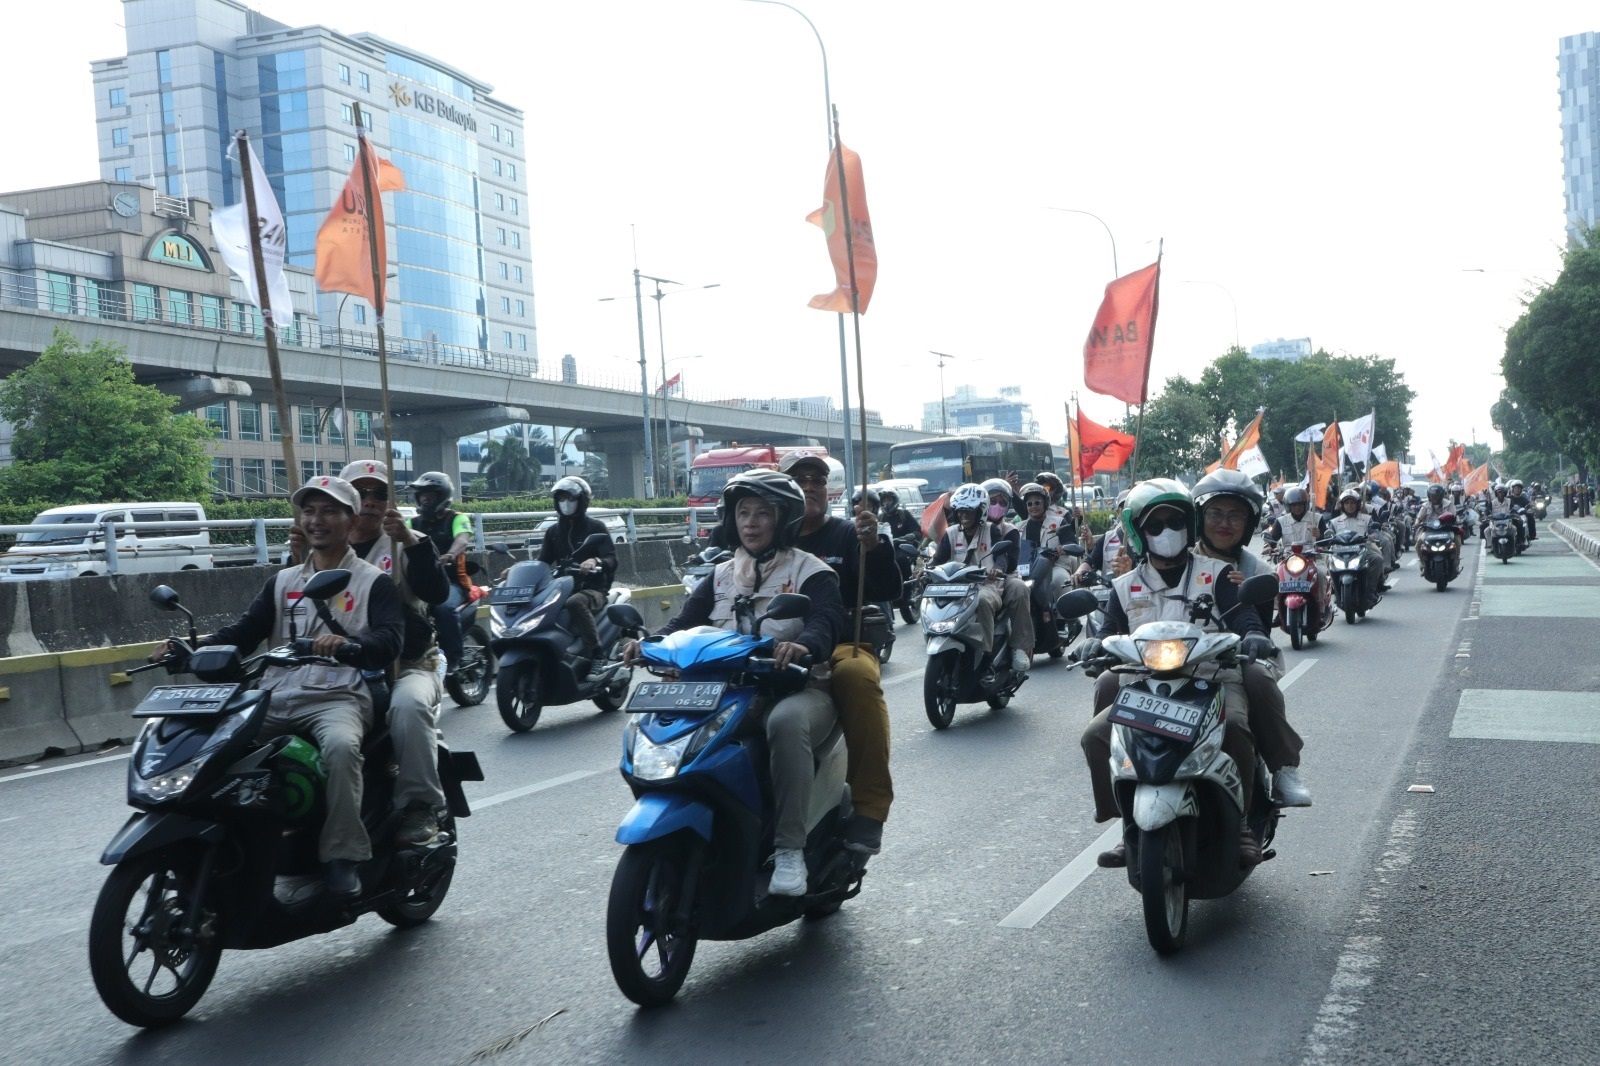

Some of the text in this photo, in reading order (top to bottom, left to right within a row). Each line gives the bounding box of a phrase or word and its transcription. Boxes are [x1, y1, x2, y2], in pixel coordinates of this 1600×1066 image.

[414, 91, 477, 133] KB Bukopin
[163, 241, 193, 262] MLI
[698, 466, 743, 475] PERTAMINA
[151, 688, 231, 700] B 3514 PLC
[639, 685, 649, 695] B
[654, 685, 686, 695] 3151
[1120, 692, 1199, 726] B 3979 TTR
